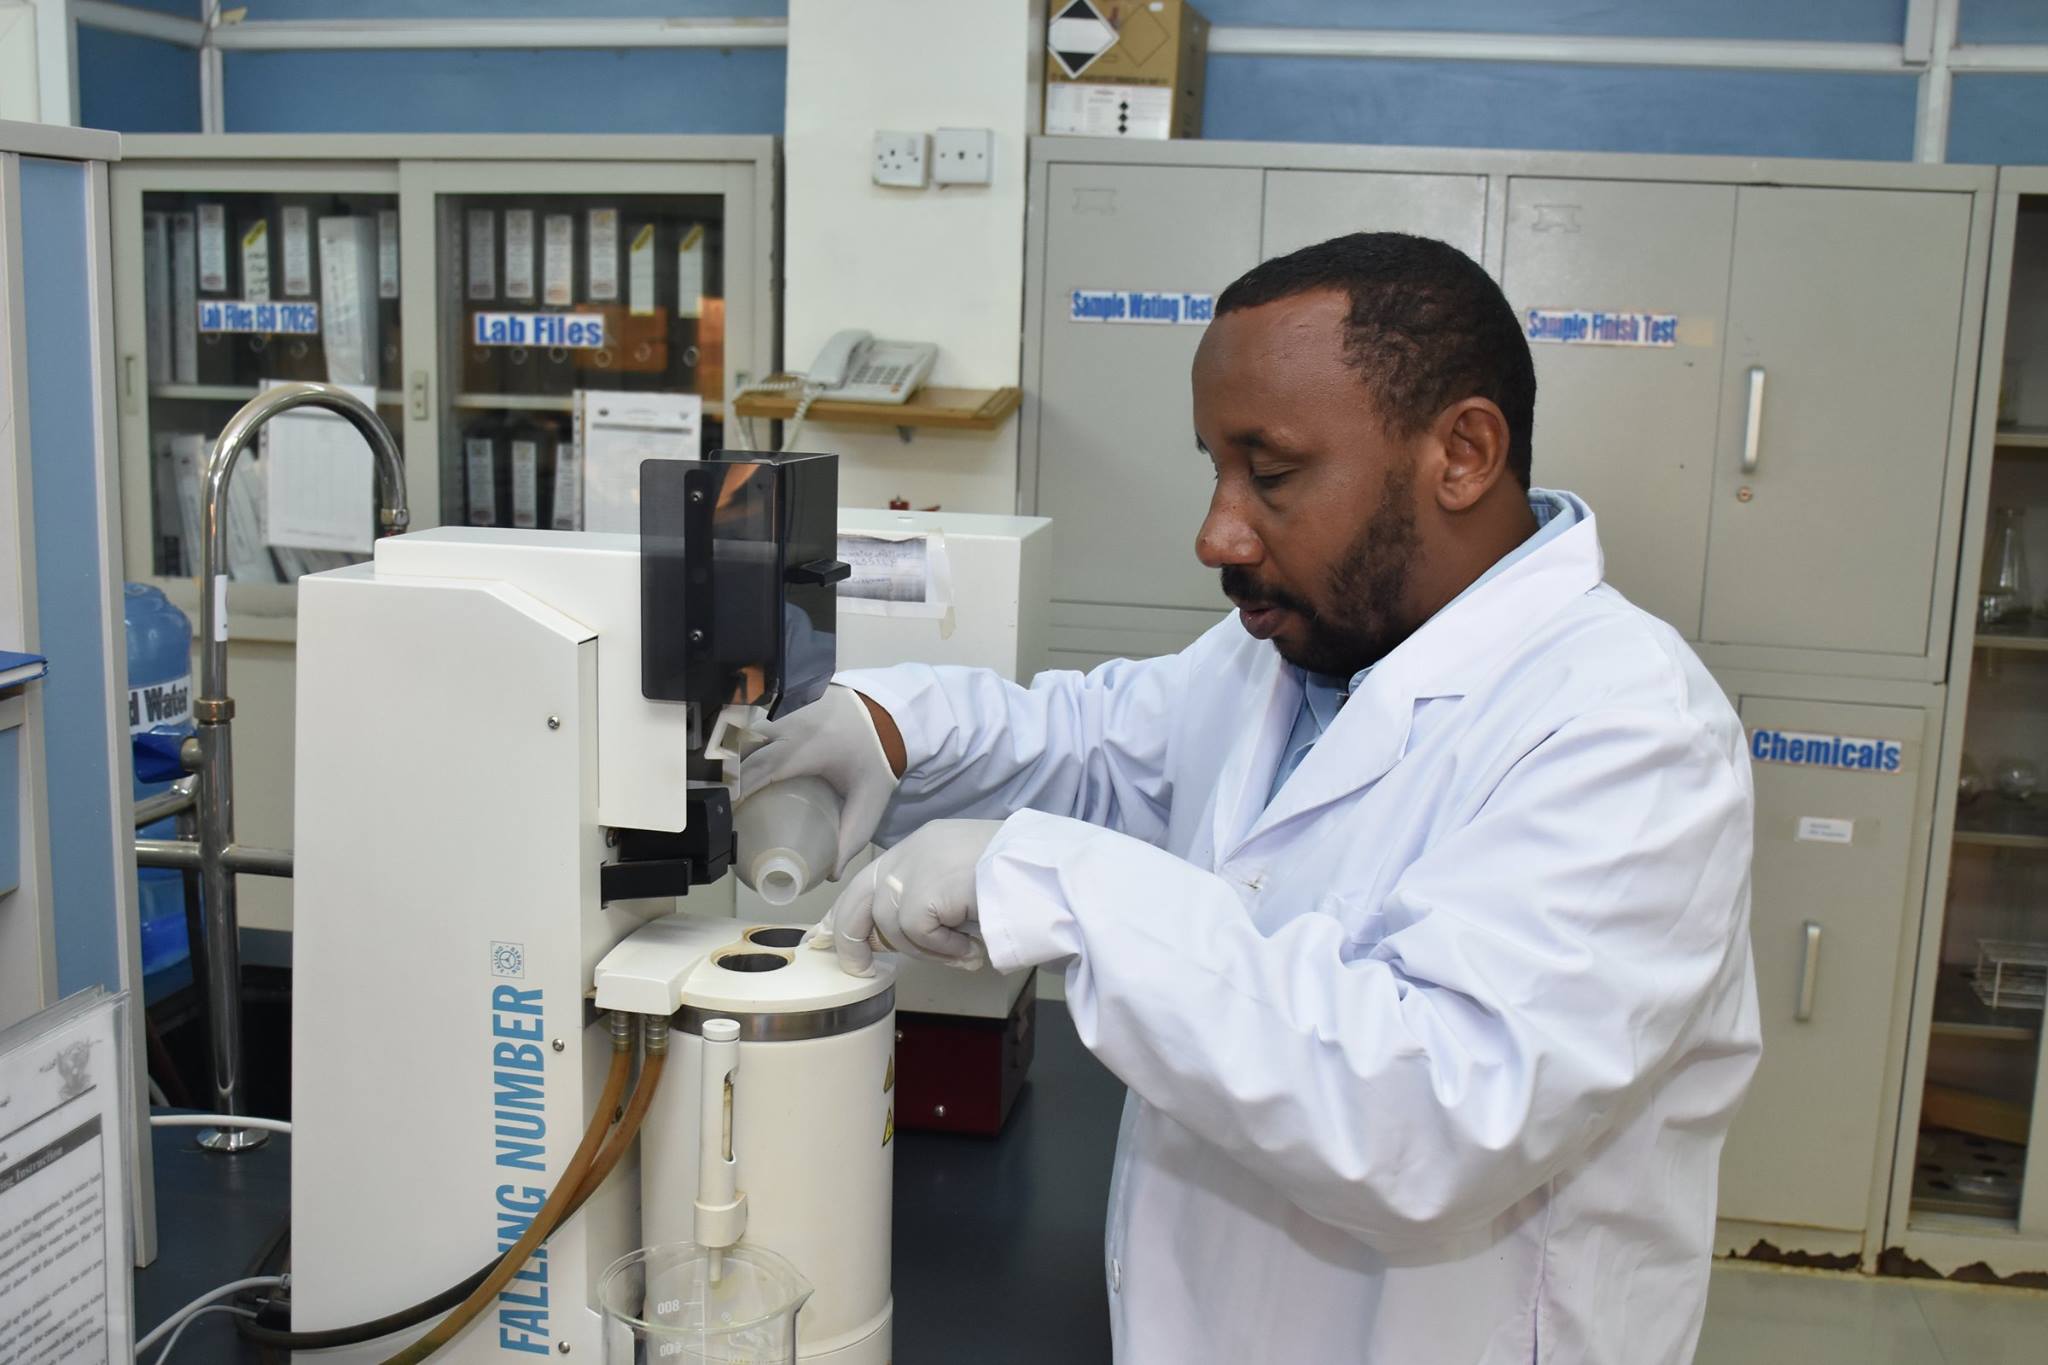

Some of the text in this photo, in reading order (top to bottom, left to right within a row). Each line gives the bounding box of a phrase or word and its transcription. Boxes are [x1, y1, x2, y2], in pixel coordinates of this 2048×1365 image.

[201, 303, 316, 331] Lab Files ISO 17025
[1072, 290, 1212, 323] Sample Wating Test
[478, 315, 603, 346] Lab Files
[1528, 310, 1678, 342] Sample Finish Test
[145, 684, 188, 722] Water
[1752, 730, 1901, 771] Chemicals
[492, 984, 546, 1171] NUMBER
